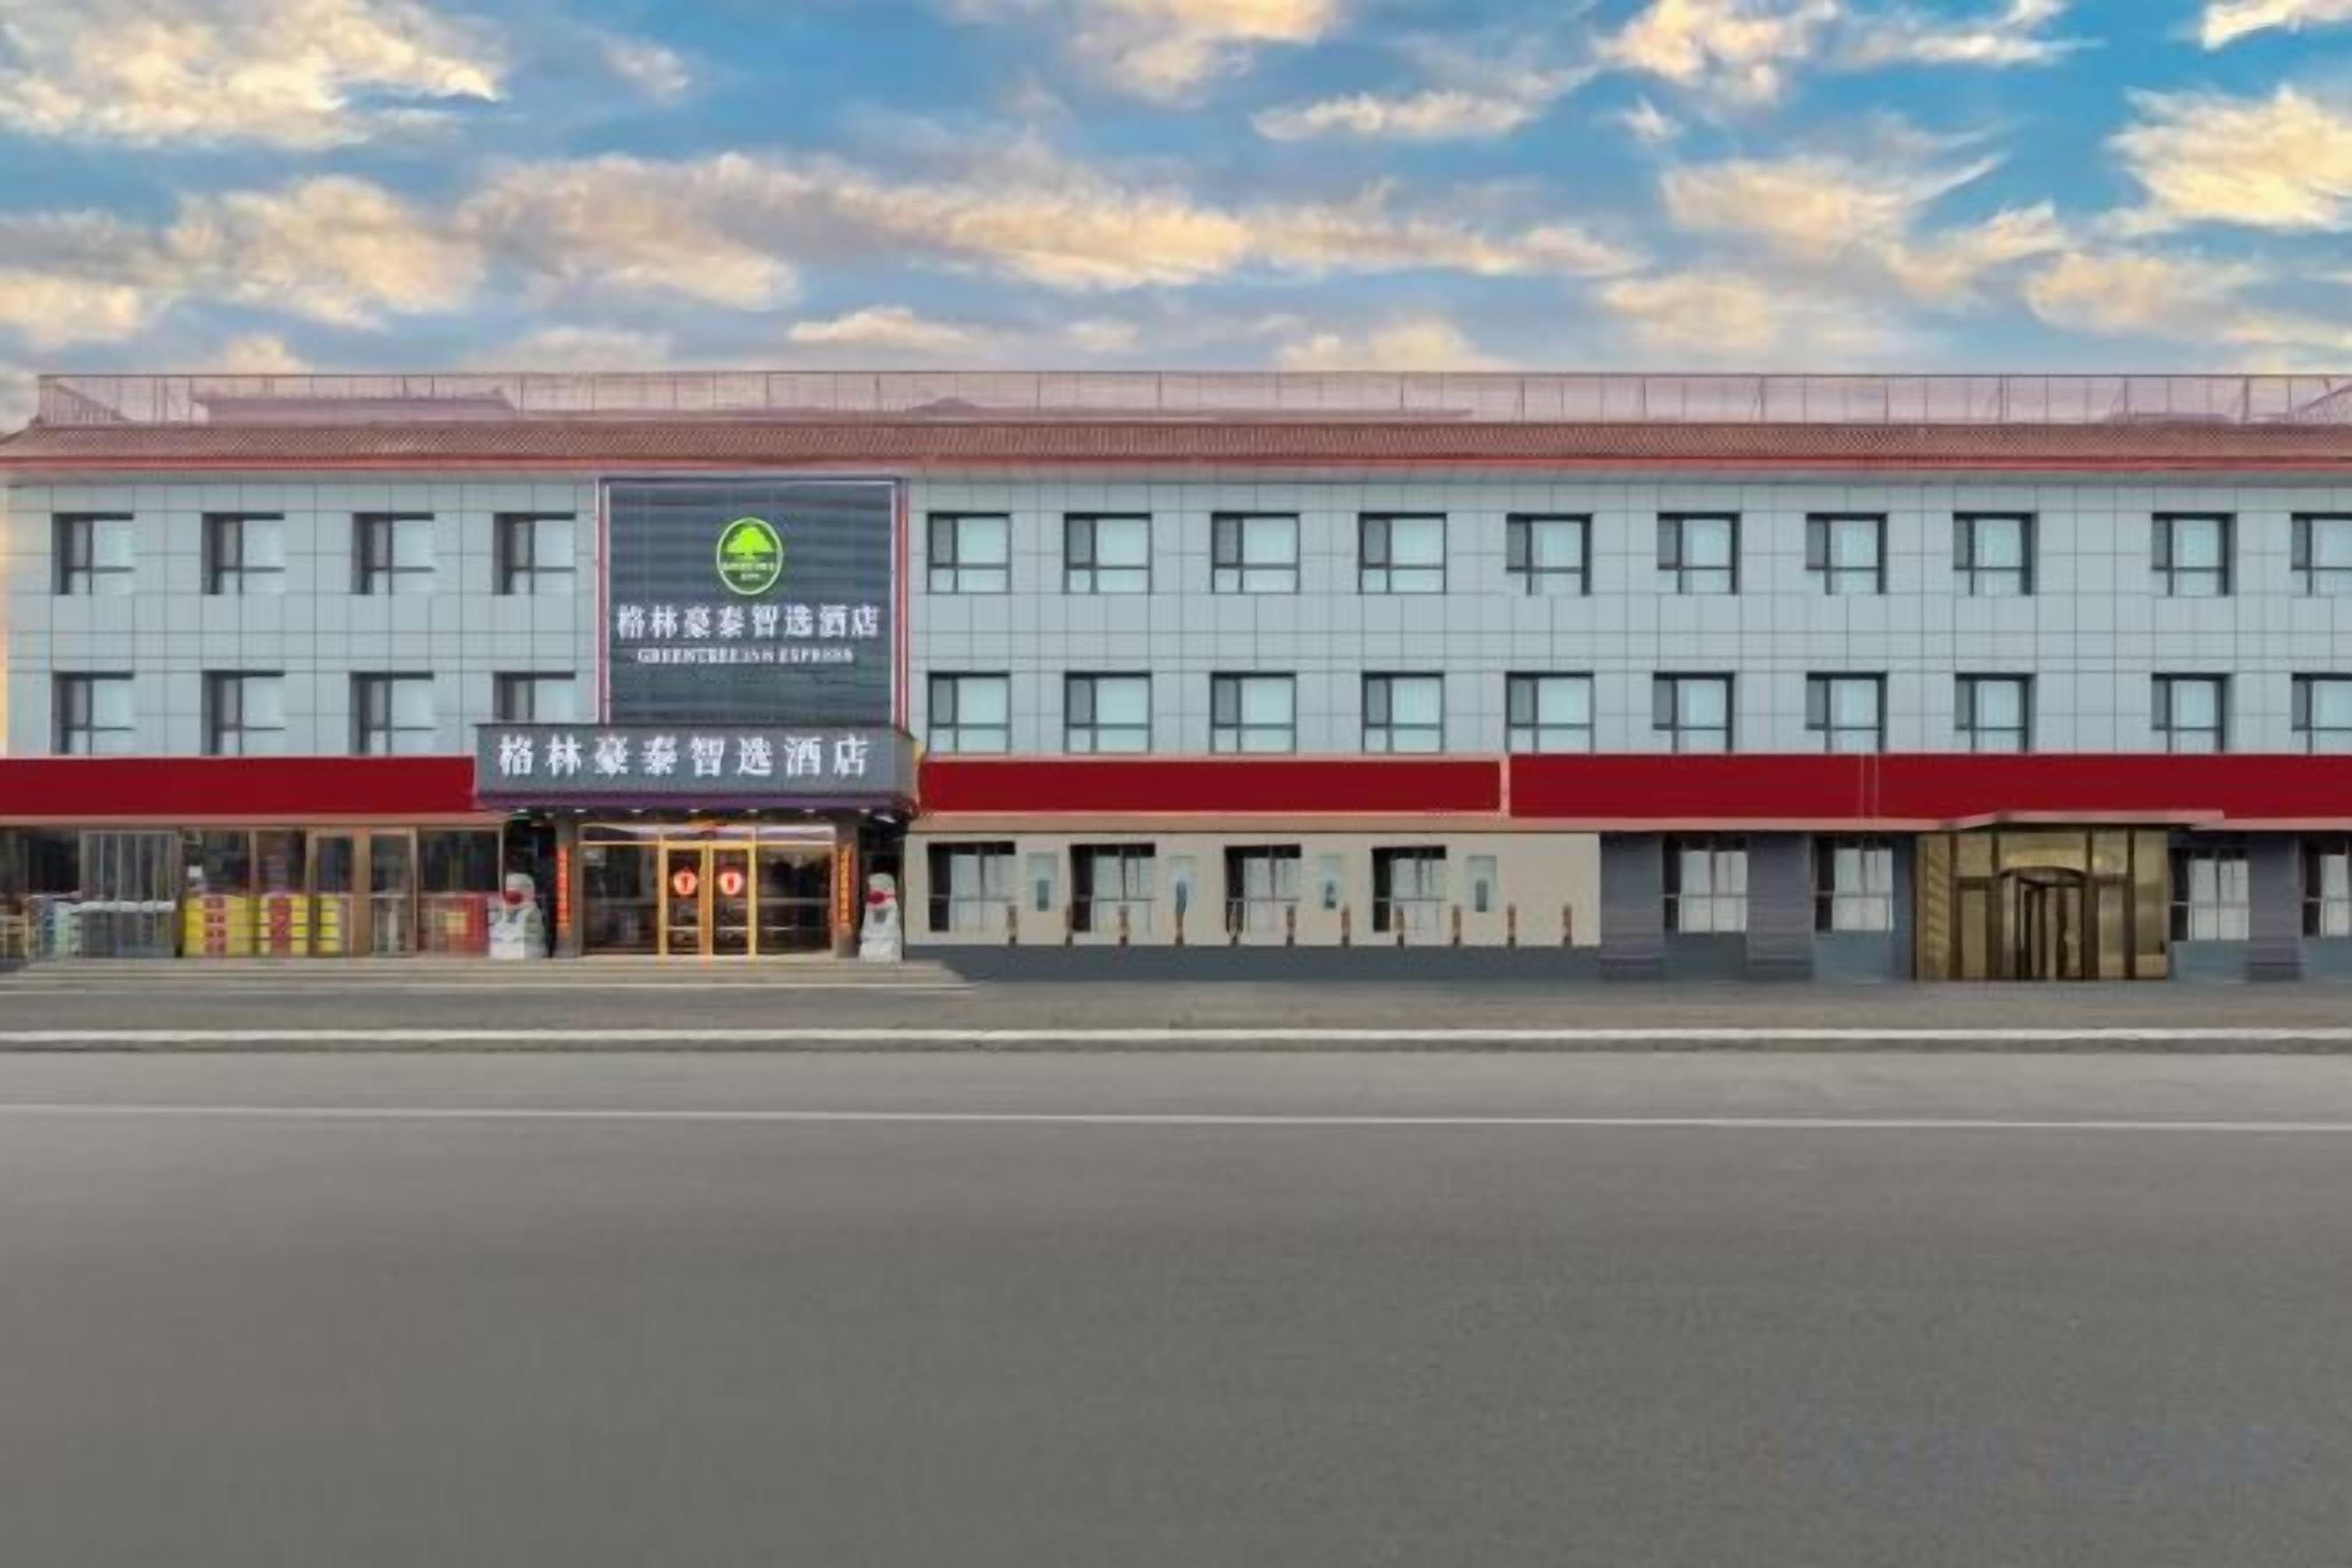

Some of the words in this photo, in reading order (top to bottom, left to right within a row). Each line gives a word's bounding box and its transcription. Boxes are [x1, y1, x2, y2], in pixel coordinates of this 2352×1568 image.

[617, 604, 878, 639] 格林豪泰智选酒店
[499, 733, 870, 778] 格林豪泰智选酒店
